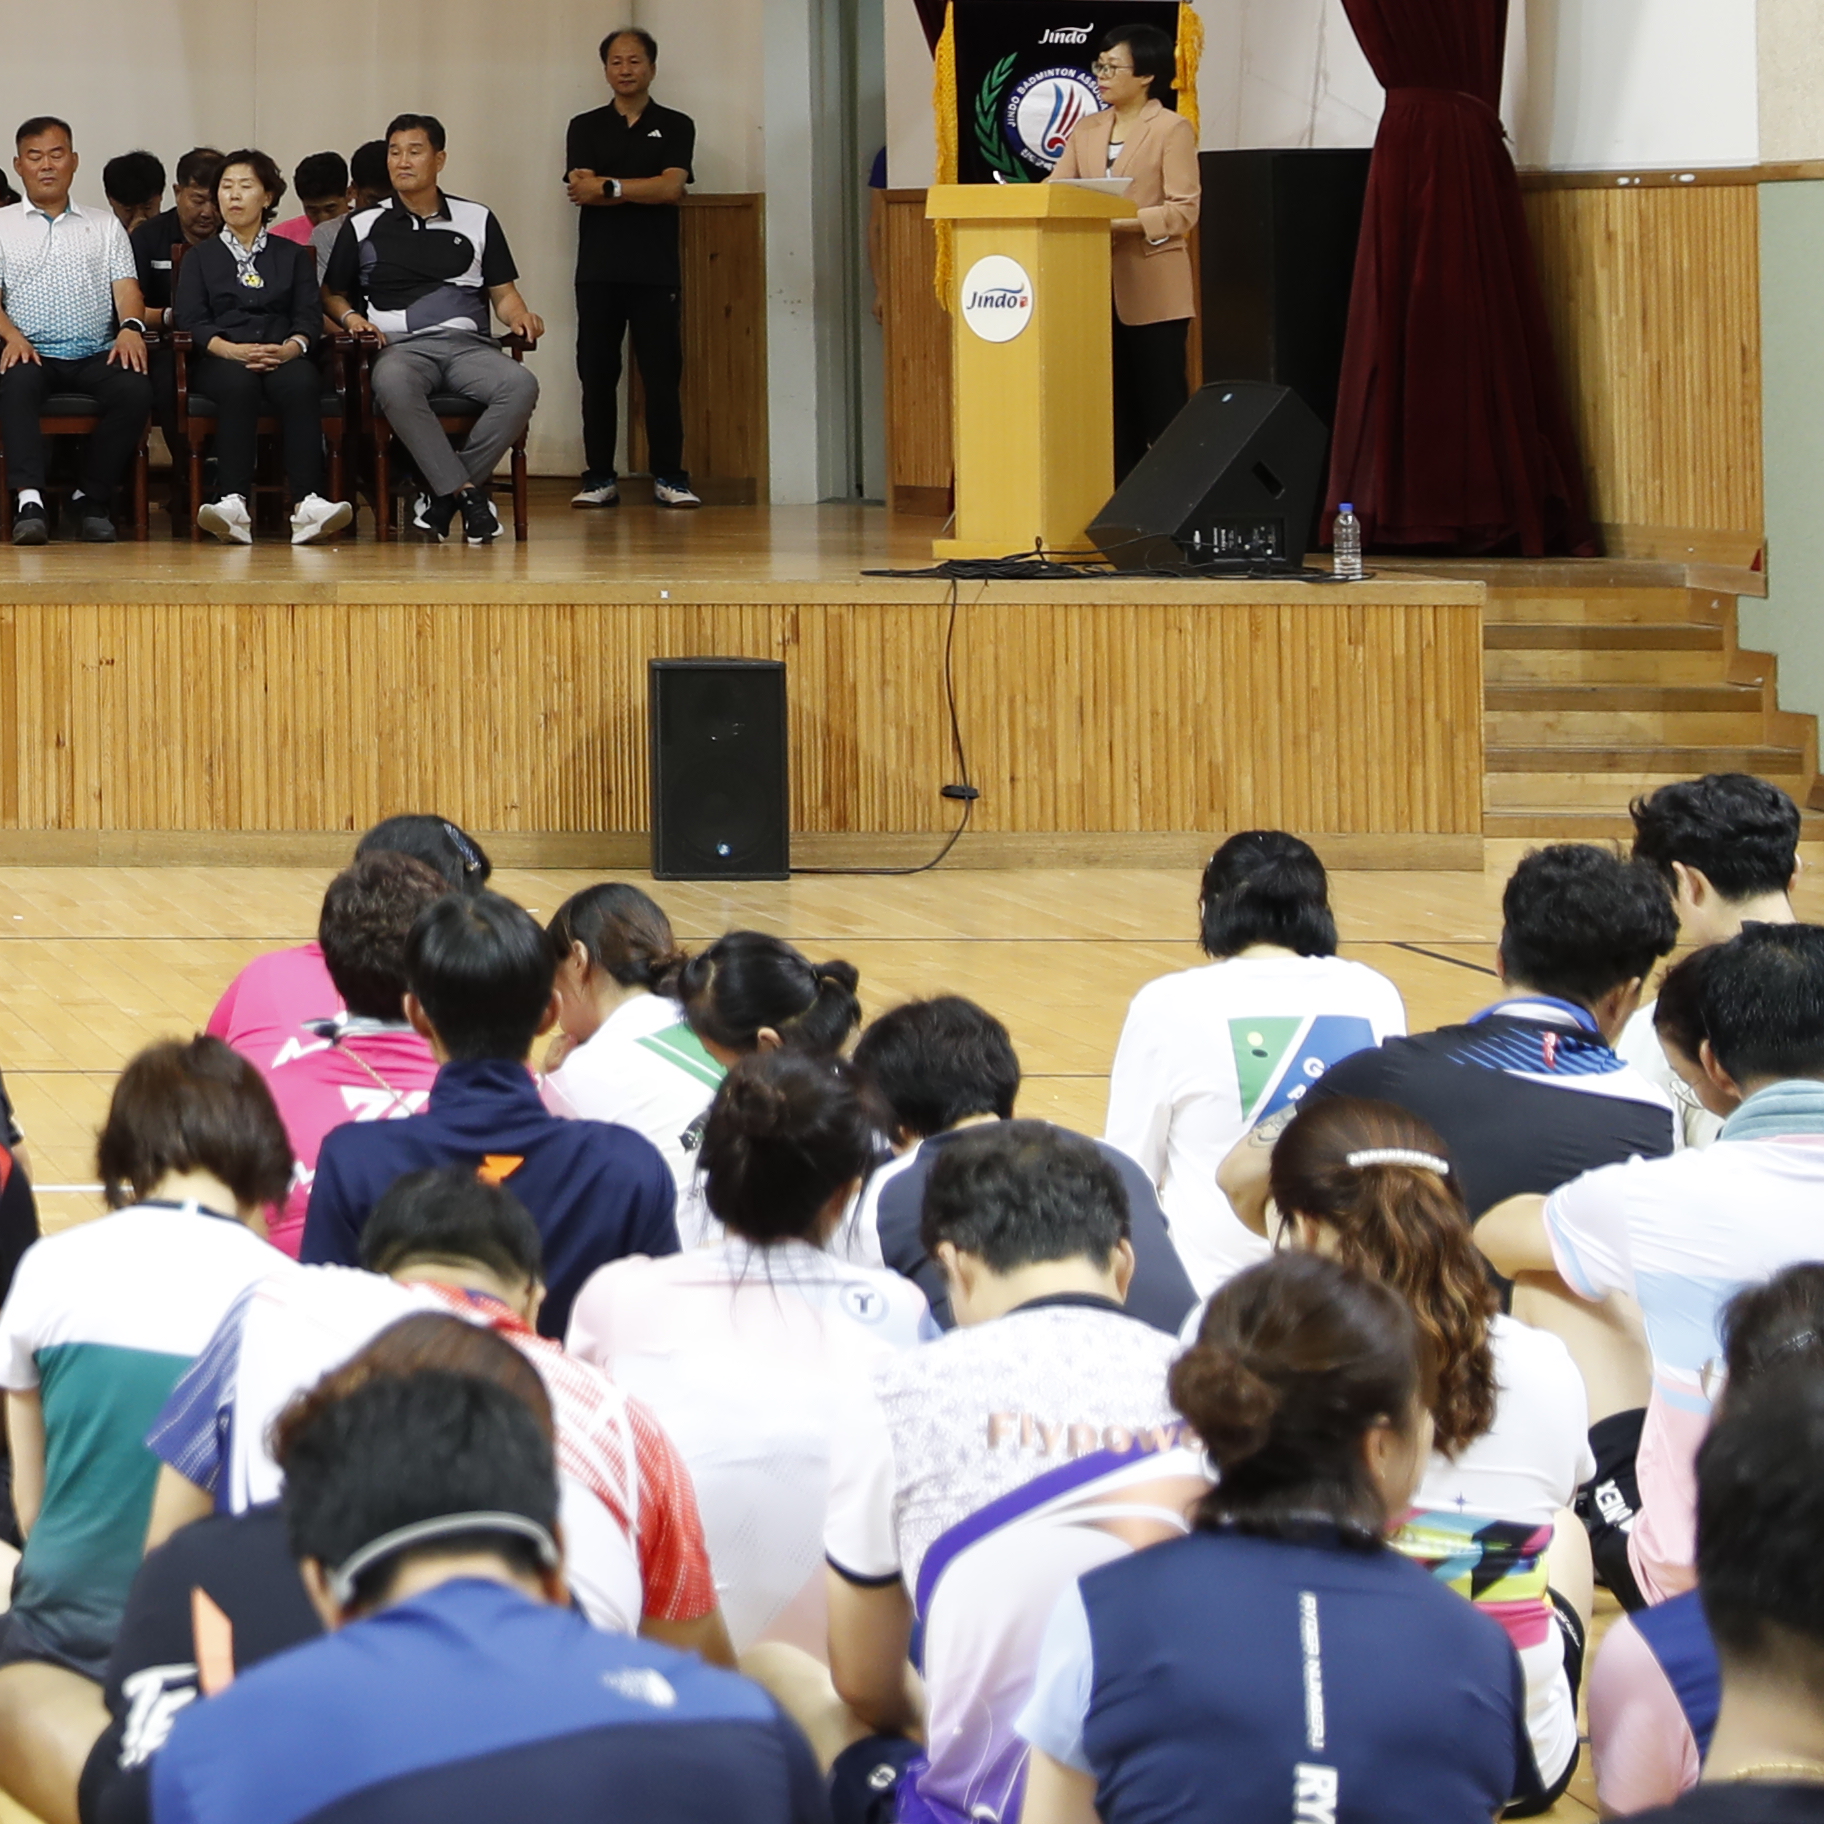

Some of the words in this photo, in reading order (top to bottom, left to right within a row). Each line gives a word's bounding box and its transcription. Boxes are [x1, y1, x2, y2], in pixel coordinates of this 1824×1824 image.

[1038, 27, 1089, 44] Jindo
[1007, 96, 1020, 127] JINDO
[1017, 68, 1076, 94] BADMINTON
[966, 290, 1018, 310] Jindo
[987, 1412, 1205, 1457] Flypowe
